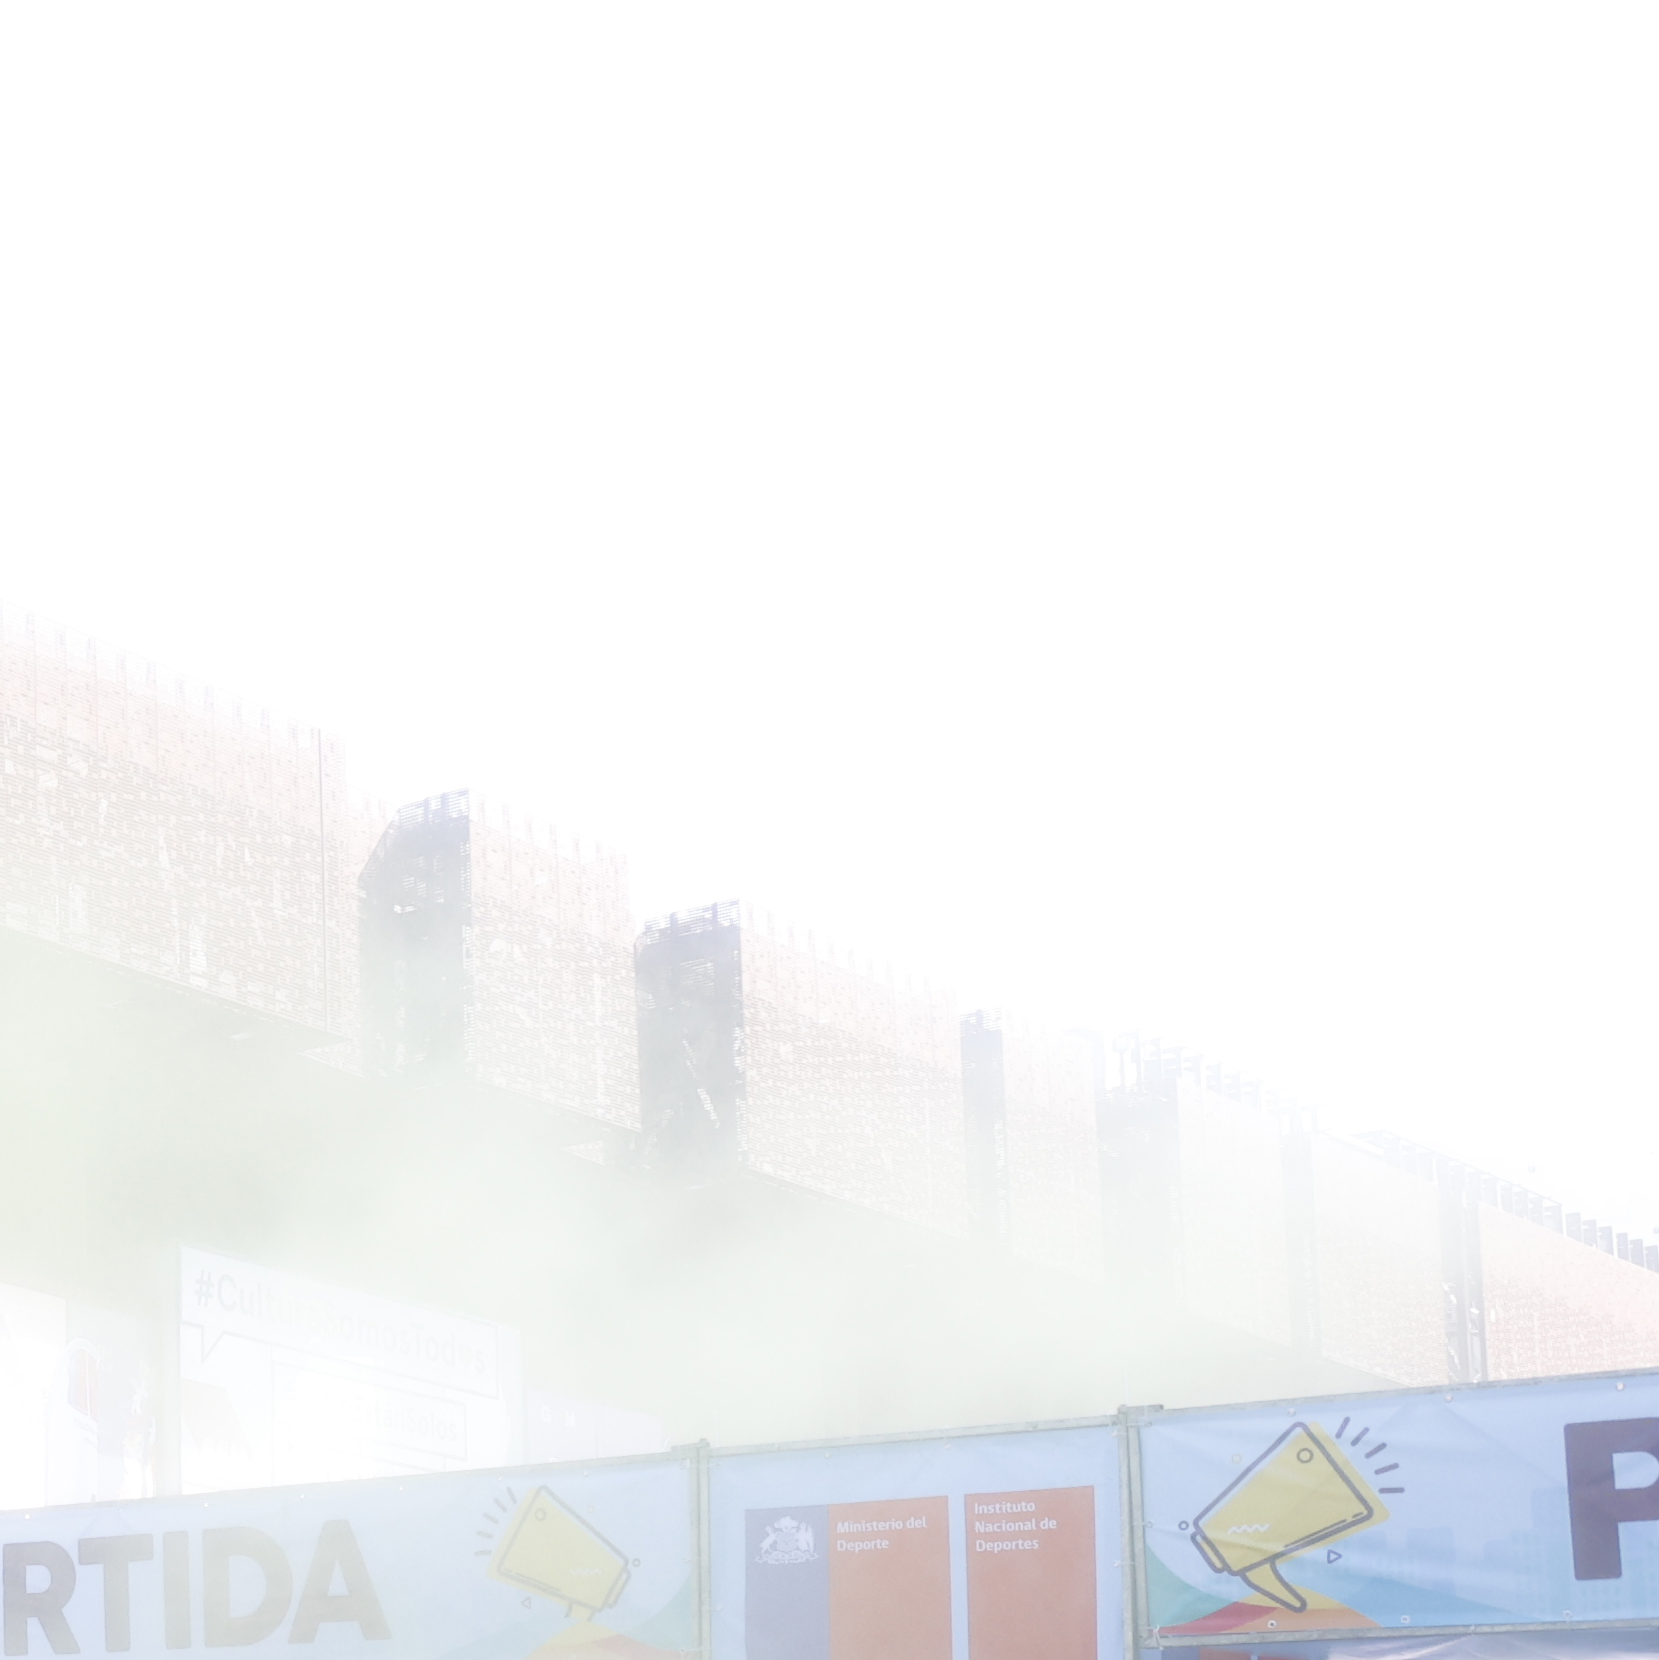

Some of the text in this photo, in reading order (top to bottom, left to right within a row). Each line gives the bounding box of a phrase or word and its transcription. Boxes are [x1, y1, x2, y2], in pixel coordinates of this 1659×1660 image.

[974, 1500, 1036, 1515] Instituto
[836, 1515, 928, 1534] Ministerio del
[974, 1516, 1058, 1534] Nacional de
[836, 1538, 890, 1554] Deporte
[975, 1537, 1040, 1553] Deportes
